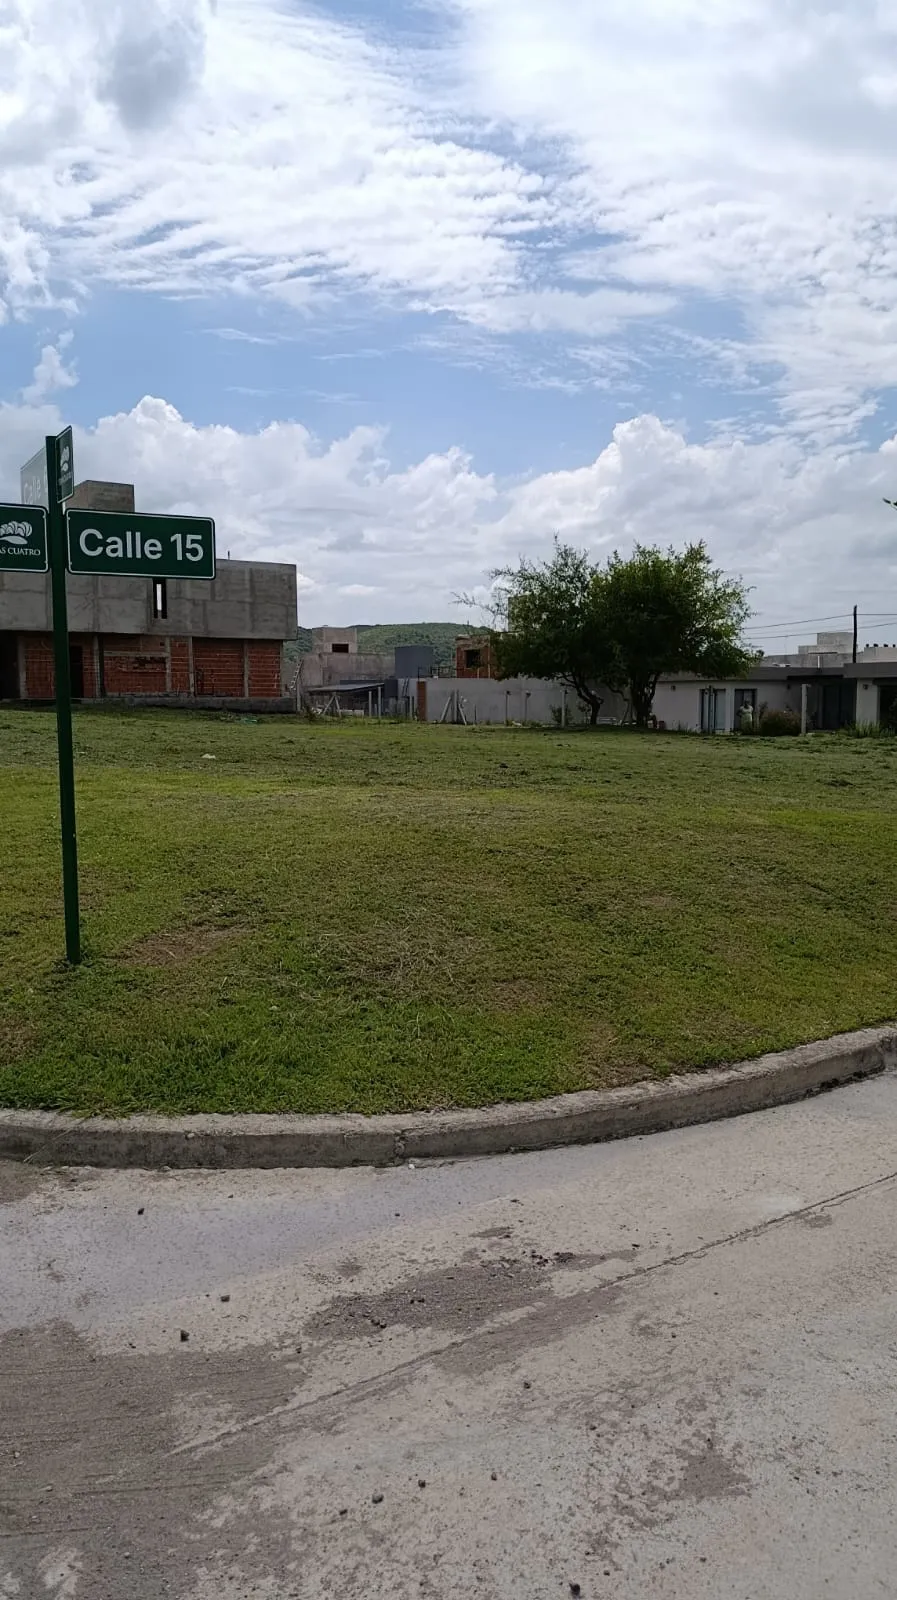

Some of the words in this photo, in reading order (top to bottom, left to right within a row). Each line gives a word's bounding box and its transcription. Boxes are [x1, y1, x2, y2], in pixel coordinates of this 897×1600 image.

[7, 547, 41, 556] CUATRO
[79, 528, 163, 560] Calle
[170, 533, 204, 562] 15
